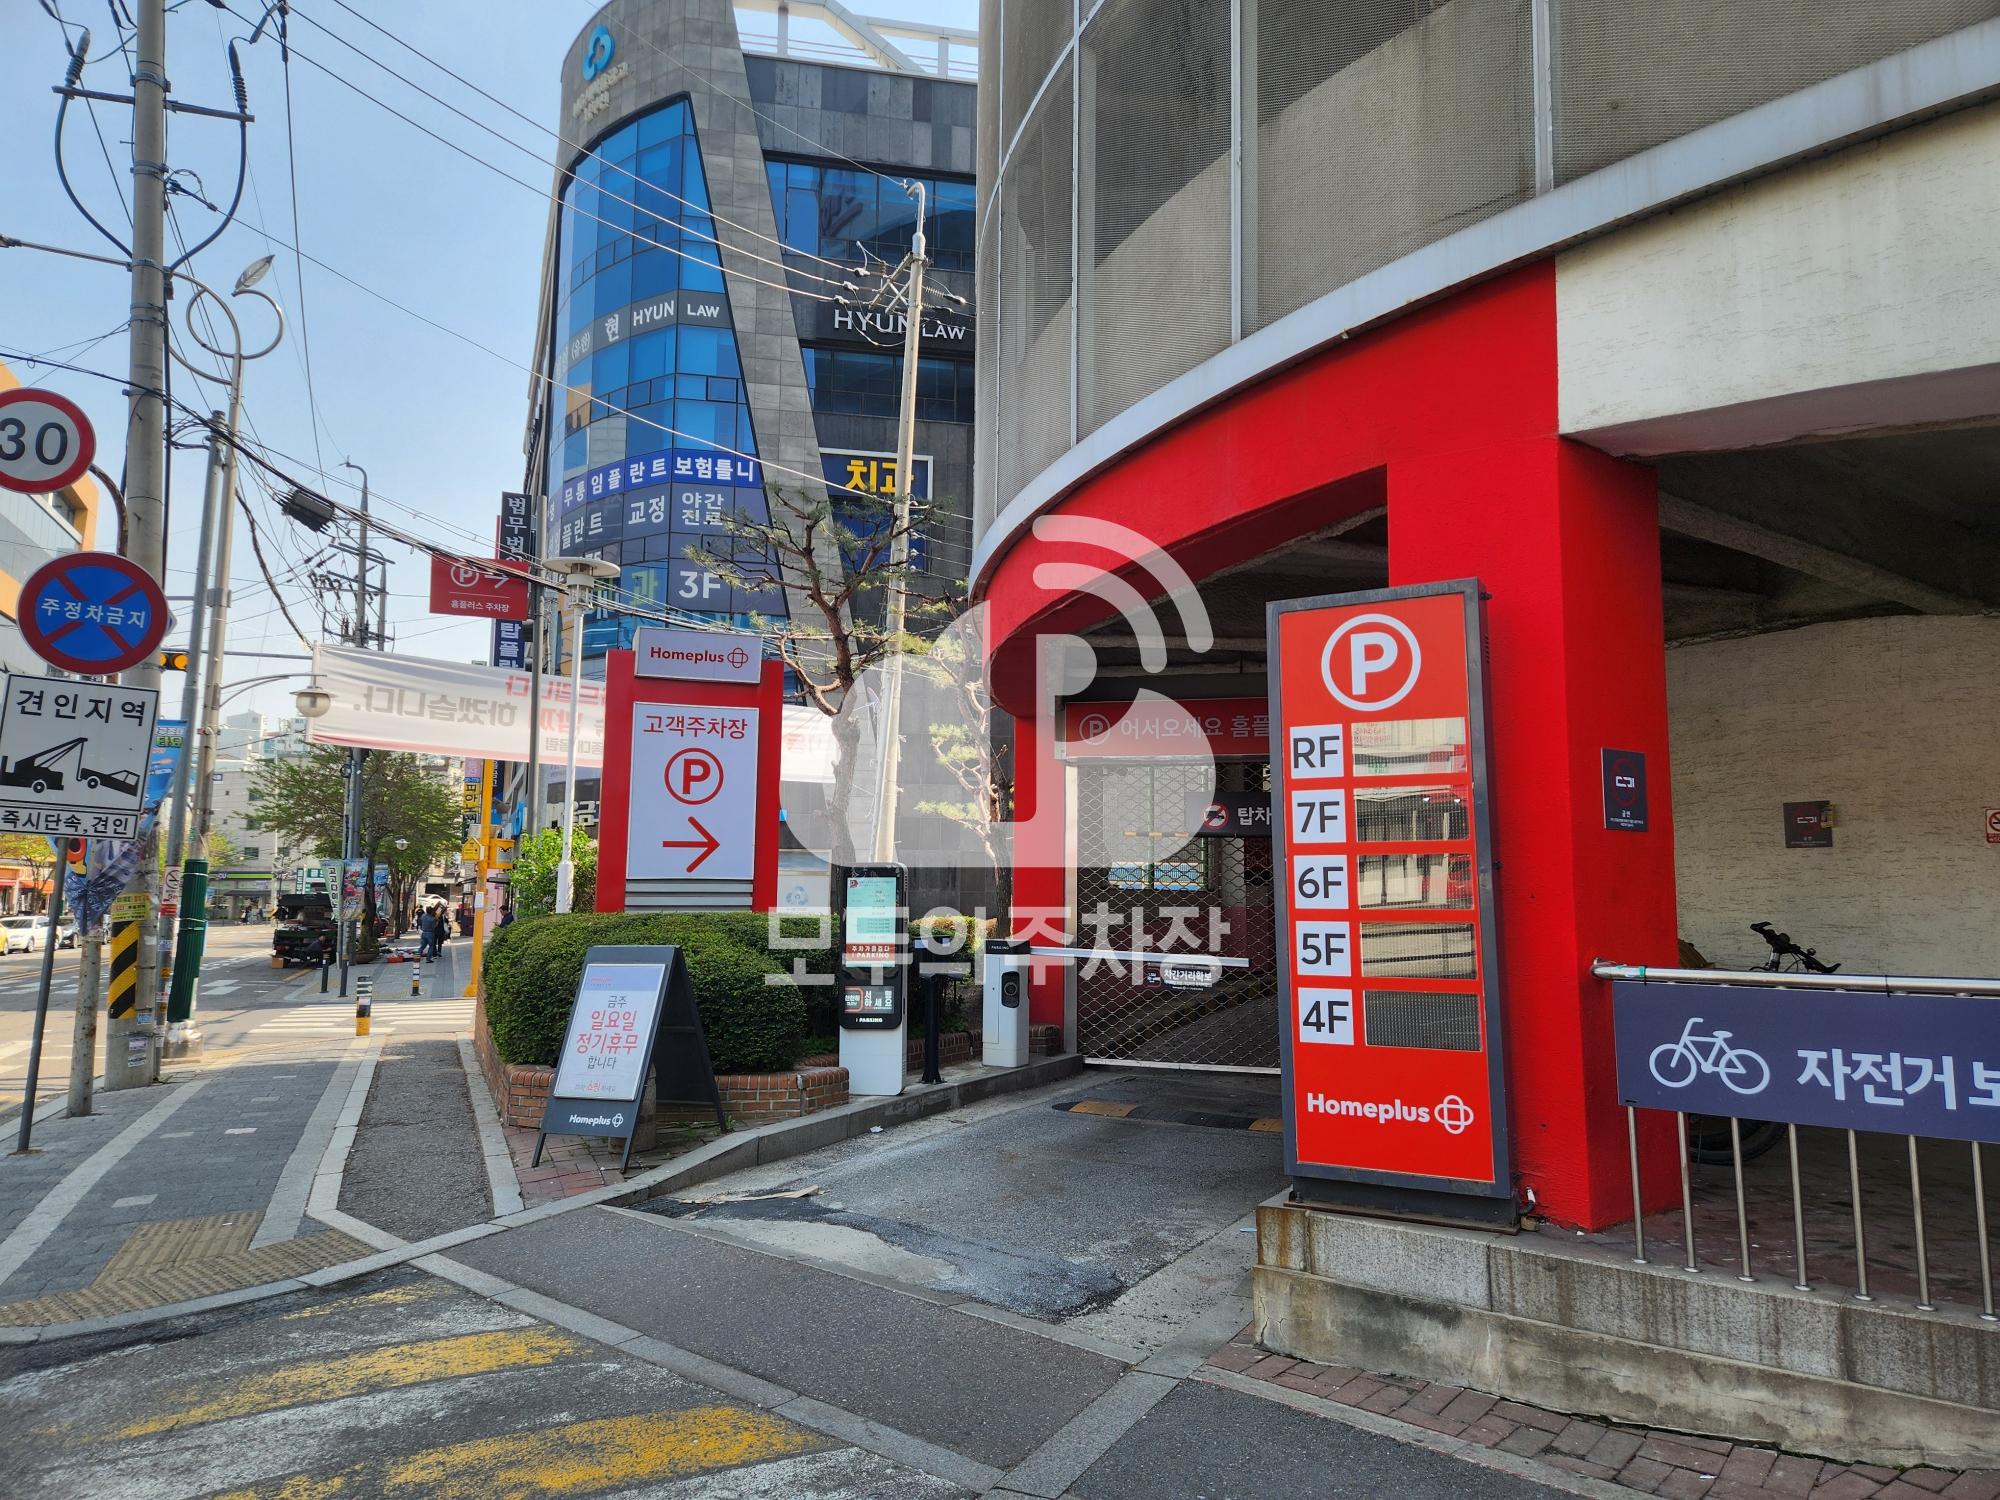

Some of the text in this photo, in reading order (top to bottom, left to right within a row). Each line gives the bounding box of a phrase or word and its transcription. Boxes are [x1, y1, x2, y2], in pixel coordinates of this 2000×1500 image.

[604, 313, 620, 343] 현
[633, 300, 675, 327] HYUN
[686, 303, 720, 319] LAW
[921, 325, 966, 341] LAW
[0, 417, 69, 466] 30
[628, 495, 666, 525] 교정
[681, 492, 725, 510] 야간
[678, 570, 721, 599] 3F
[40, 596, 146, 629] 주정차금지
[451, 599, 509, 612] 홈플러스 주차장
[650, 646, 725, 664] Homeplus
[17, 689, 146, 727] 견인지역
[643, 714, 749, 740] 고객주차장
[1120, 716, 1224, 740] 어서오세요
[1292, 735, 1340, 769] RF
[1296, 800, 1340, 834] 7F
[1297, 866, 1344, 900] 6F
[1301, 932, 1346, 966] 5F
[607, 995, 627, 1009] 금주
[591, 1009, 638, 1032] 일요일
[1302, 1000, 1350, 1034] 4F
[576, 1032, 640, 1056] 정기휴무
[587, 1055, 618, 1071] 합니다
[1796, 1047, 1957, 1111] 자전거
[569, 1113, 612, 1127] Homeplus
[1306, 1091, 1431, 1125] Homeplus
